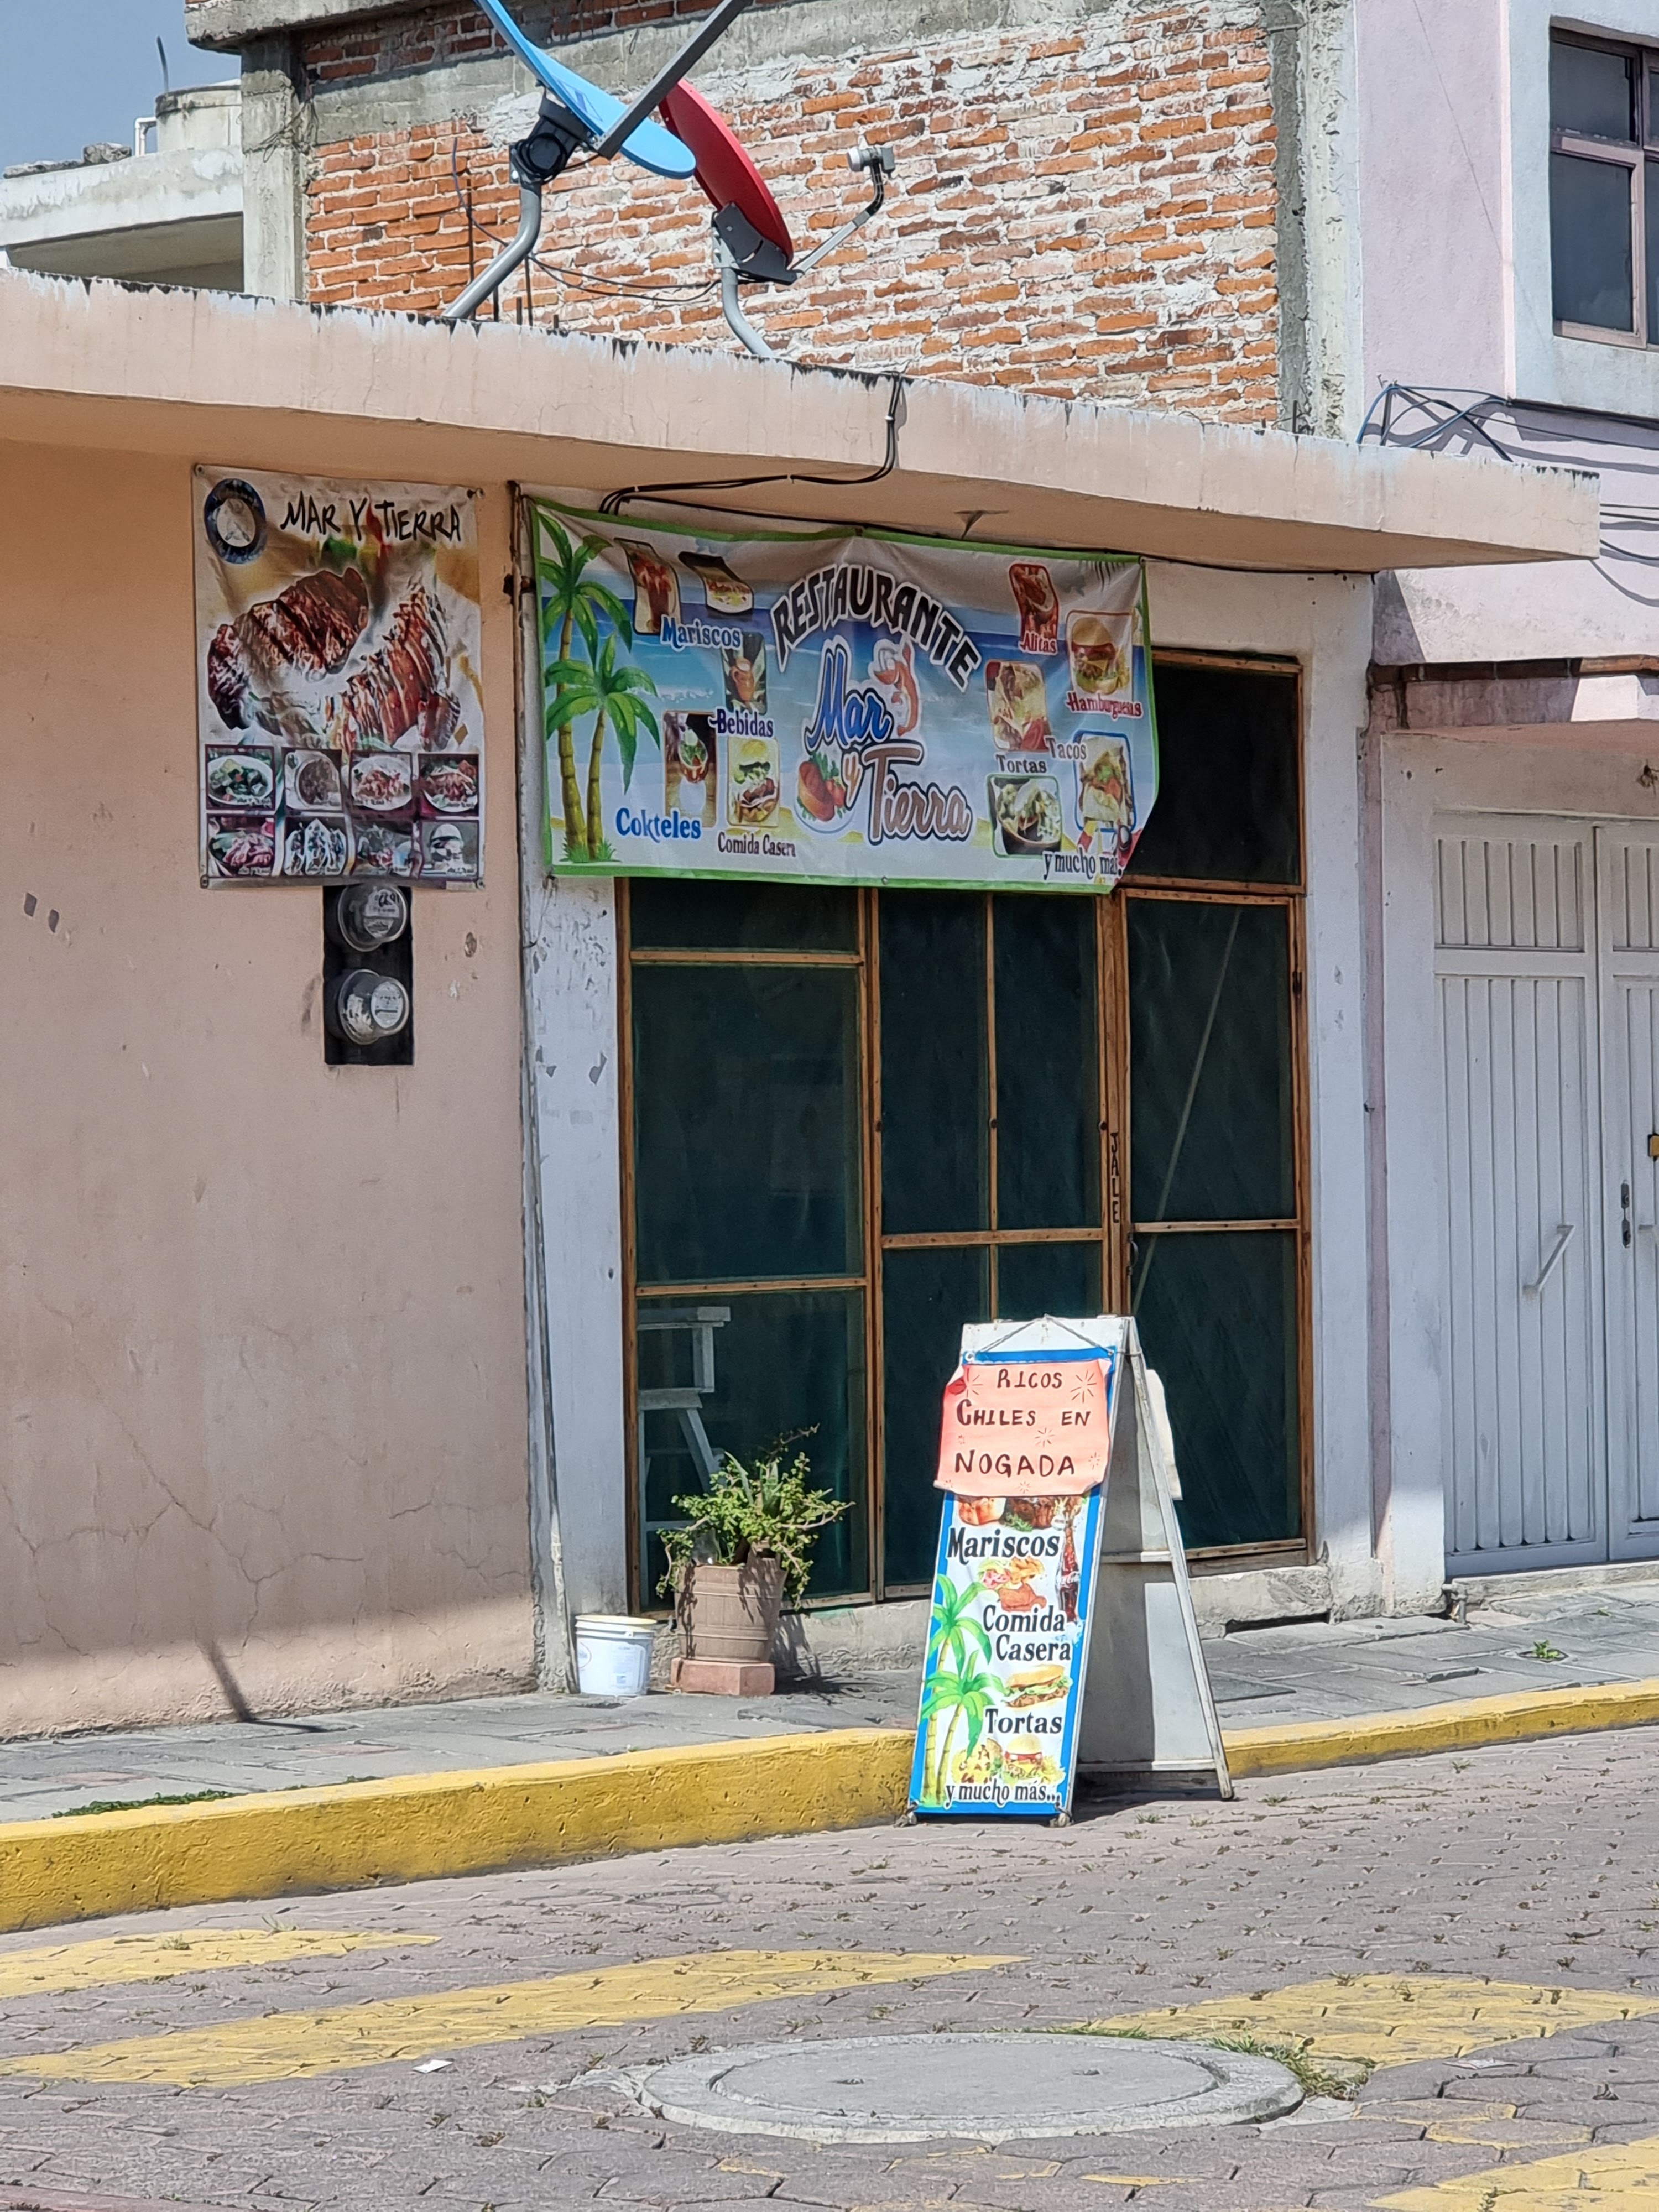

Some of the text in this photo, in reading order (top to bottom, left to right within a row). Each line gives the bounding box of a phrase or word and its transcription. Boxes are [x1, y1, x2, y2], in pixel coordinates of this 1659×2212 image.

[280, 490, 462, 542] MAR Y TIERRA
[661, 616, 742, 649] Mariscos
[773, 567, 980, 693] RESTAURANTE
[1020, 633, 1057, 654] Alitas
[805, 644, 893, 752] Mar
[709, 708, 774, 738] Bebidas
[996, 753, 1047, 774] Tortas
[1046, 737, 1087, 760] Tacos
[843, 741, 972, 844] y Tierra
[615, 807, 702, 844] Cokteles
[718, 831, 760, 854] Comida
[1044, 853, 1053, 880] y
[1054, 847, 1097, 879] mucho
[1110, 1131, 1120, 1224] JALE
[997, 1368, 1063, 1389] RICOS
[956, 1399, 1092, 1427] CHILES EN
[954, 1449, 1075, 1478] NOGADA
[947, 1527, 1060, 1566] Mariscos
[983, 1604, 1065, 1633] Comida
[995, 1633, 1072, 1662] Casera
[985, 1708, 1063, 1734] Tortas
[945, 1785, 956, 1808] y
[958, 1778, 1010, 1806] mucho
